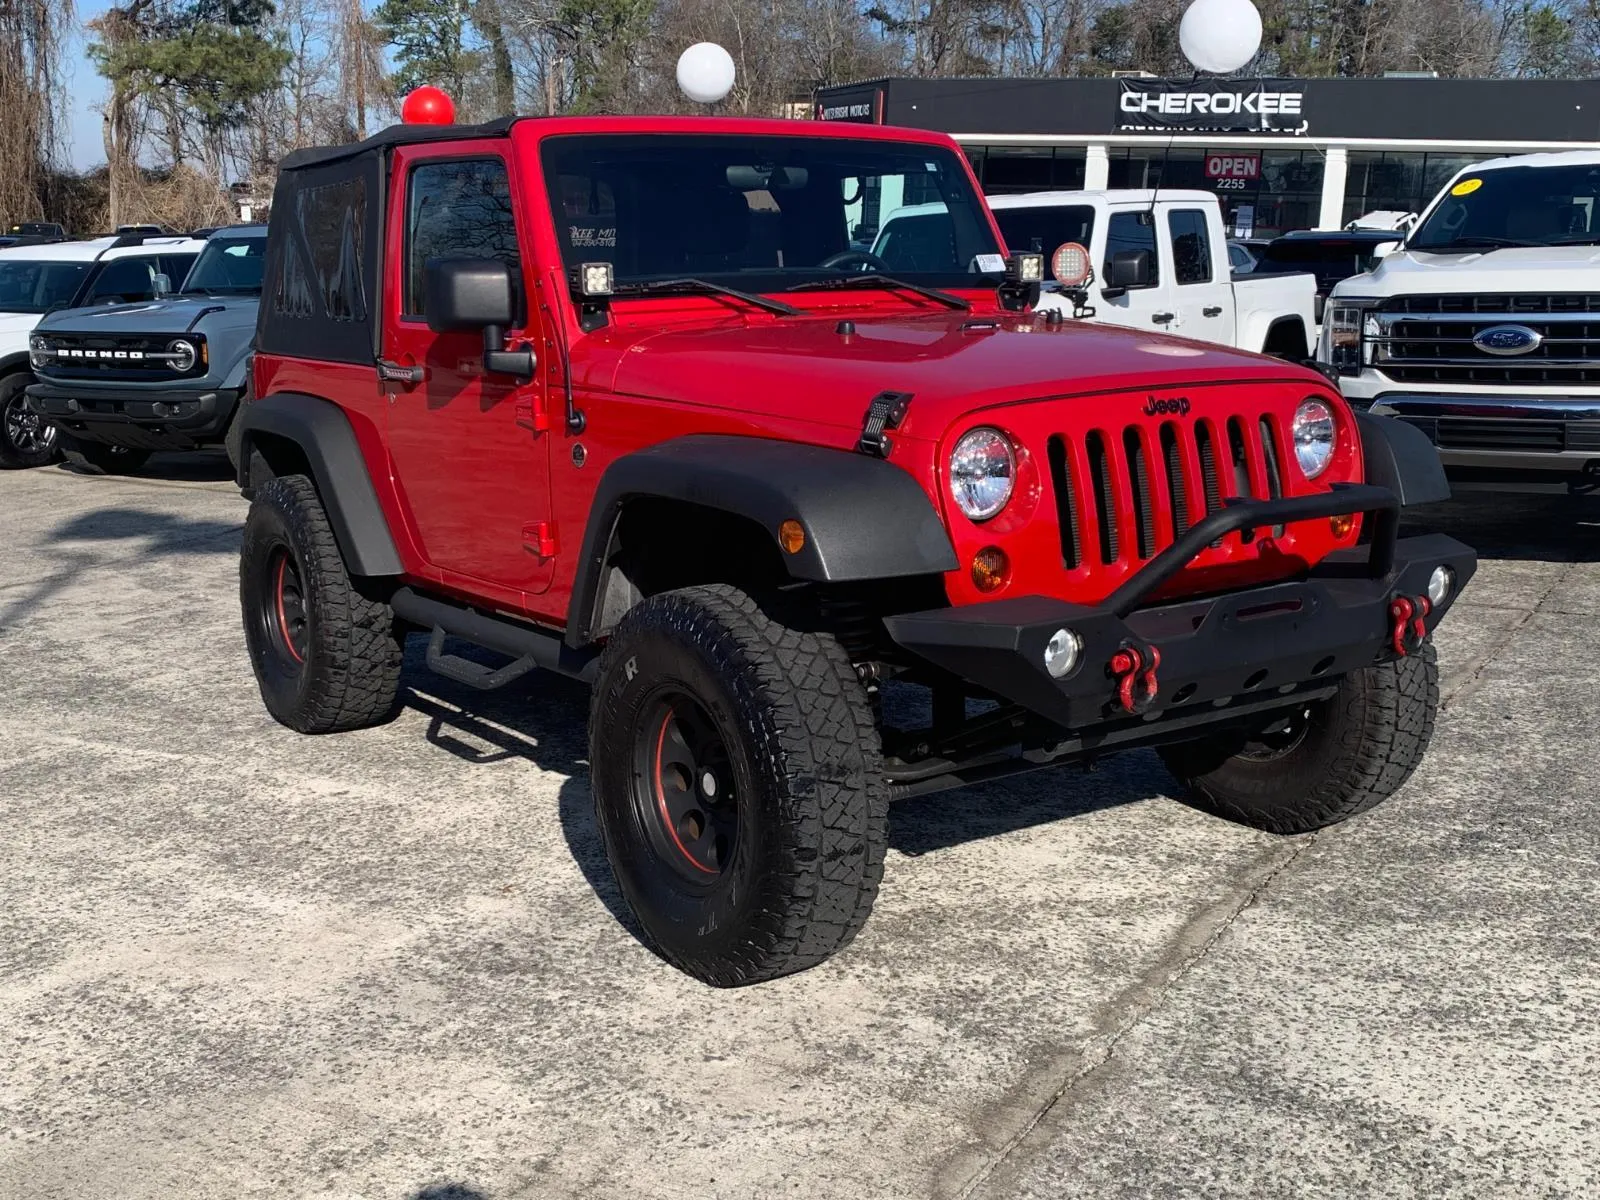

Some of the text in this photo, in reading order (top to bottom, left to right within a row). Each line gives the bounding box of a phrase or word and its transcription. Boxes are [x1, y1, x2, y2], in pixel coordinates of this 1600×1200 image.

[1120, 91, 1303, 114] CHEROKEE
[1208, 156, 1257, 176] OPEN
[1216, 178, 1247, 189] 2255
[57, 349, 144, 359] BRONCO
[1142, 395, 1191, 417] Jeep
